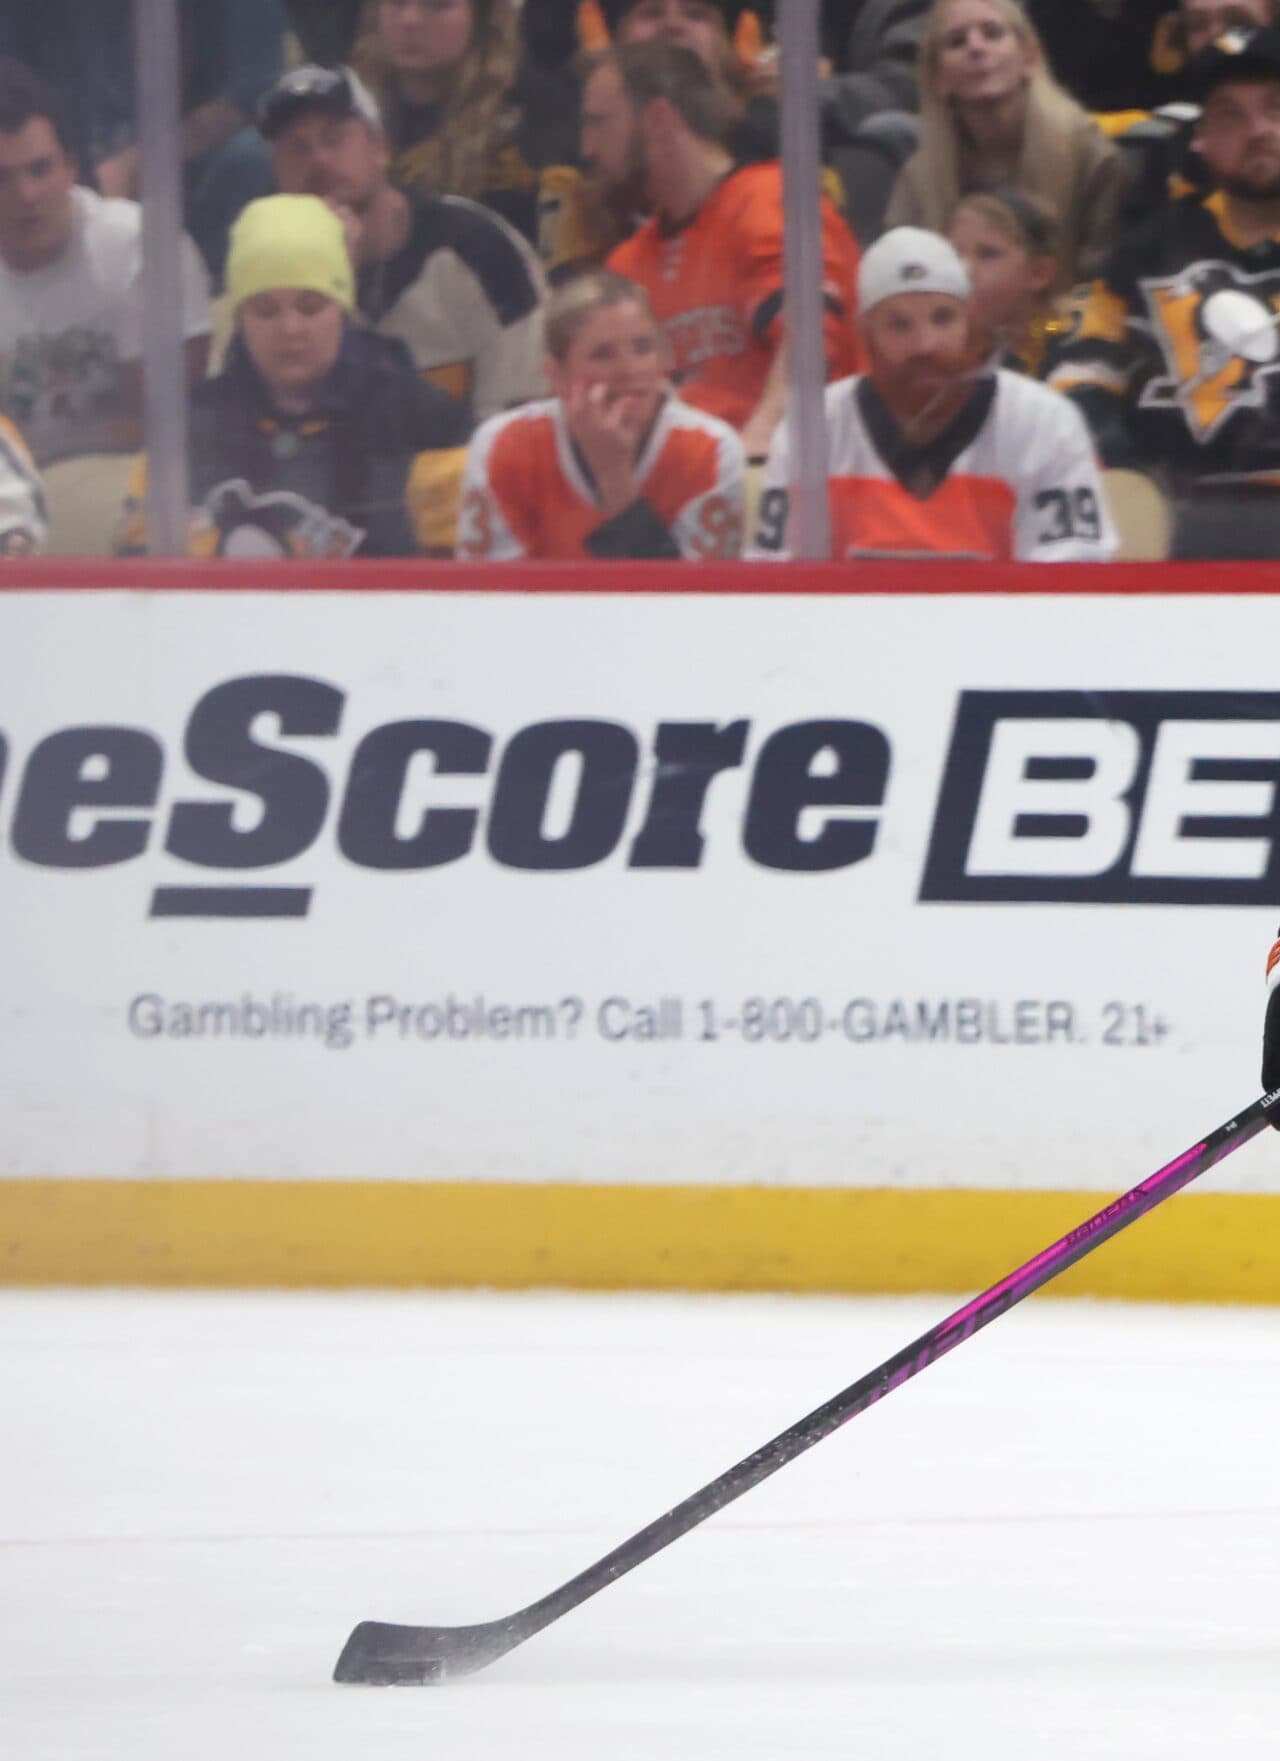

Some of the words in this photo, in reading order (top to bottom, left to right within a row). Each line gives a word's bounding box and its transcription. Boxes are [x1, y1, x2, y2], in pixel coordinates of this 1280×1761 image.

[1034, 486, 1099, 543] 39
[0, 672, 892, 873] eScore
[127, 994, 353, 1049] Gambling
[366, 996, 582, 1042] Problem?
[599, 997, 685, 1042] Call
[1102, 1001, 1170, 1046] 21+
